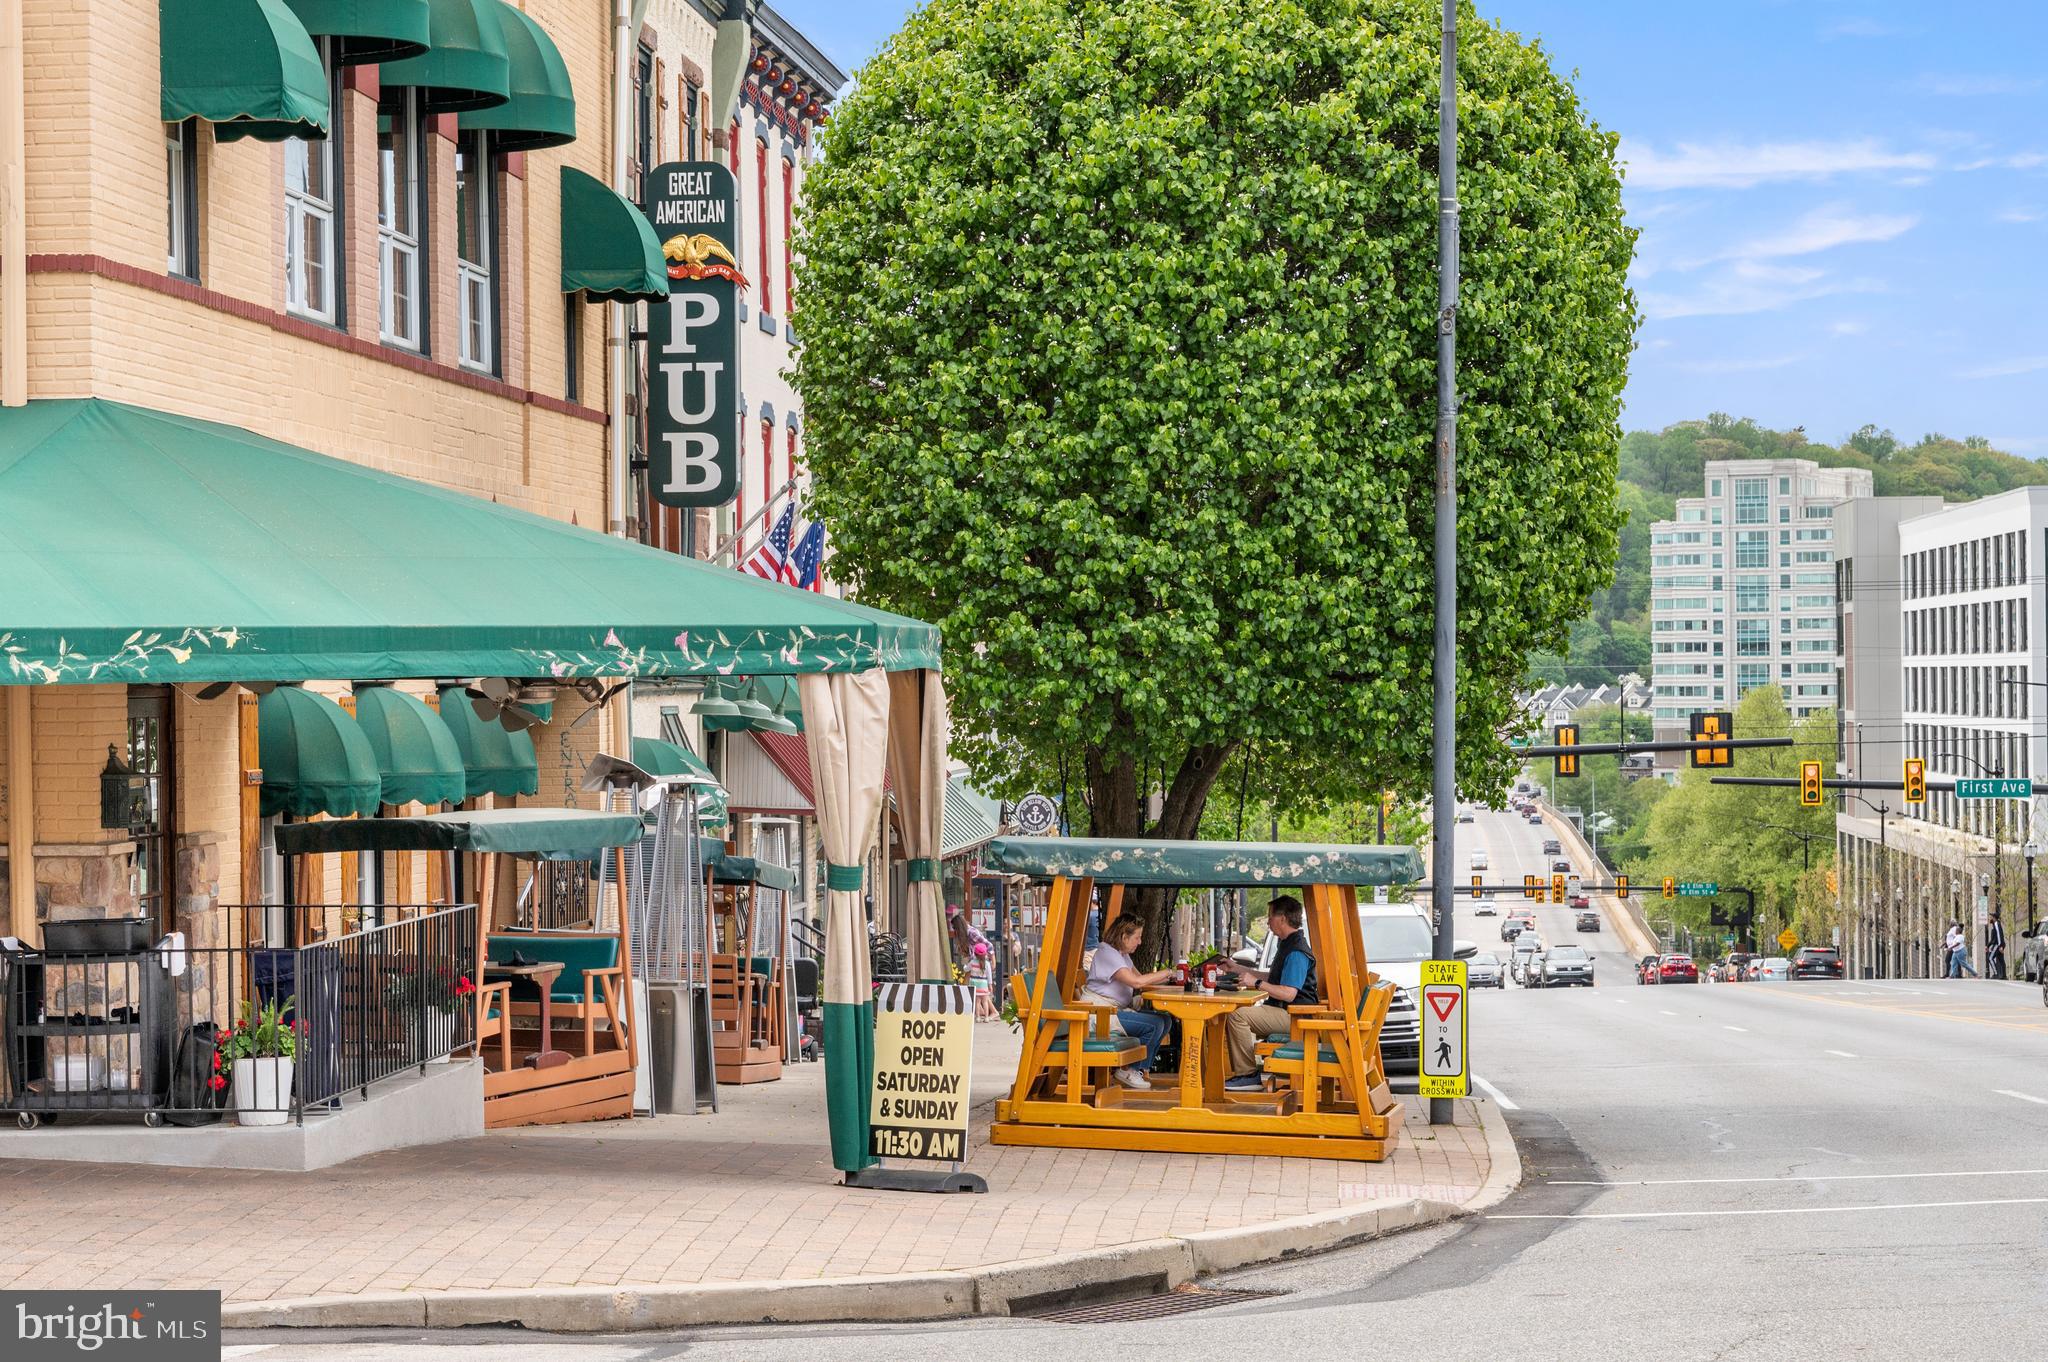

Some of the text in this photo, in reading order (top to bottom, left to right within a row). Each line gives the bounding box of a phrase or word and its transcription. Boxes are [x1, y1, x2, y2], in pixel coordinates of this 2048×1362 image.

[668, 172, 712, 196] GREAT
[656, 200, 726, 224] AMERICAN
[718, 267, 731, 276] BAR
[659, 293, 724, 493] PUB
[1962, 781, 2026, 793] First Ave
[1428, 964, 1458, 973] STATE
[1433, 974, 1455, 983] LAW
[902, 1020, 946, 1040] ROOF
[900, 1046, 944, 1067] OPEN
[877, 1071, 960, 1094] SATURDAY
[1421, 1086, 1464, 1096] CROSSWALK
[1430, 1079, 1455, 1087] WITHIN
[880, 1098, 959, 1121] & SUNDAY
[875, 1129, 960, 1159] 11:30 AM
